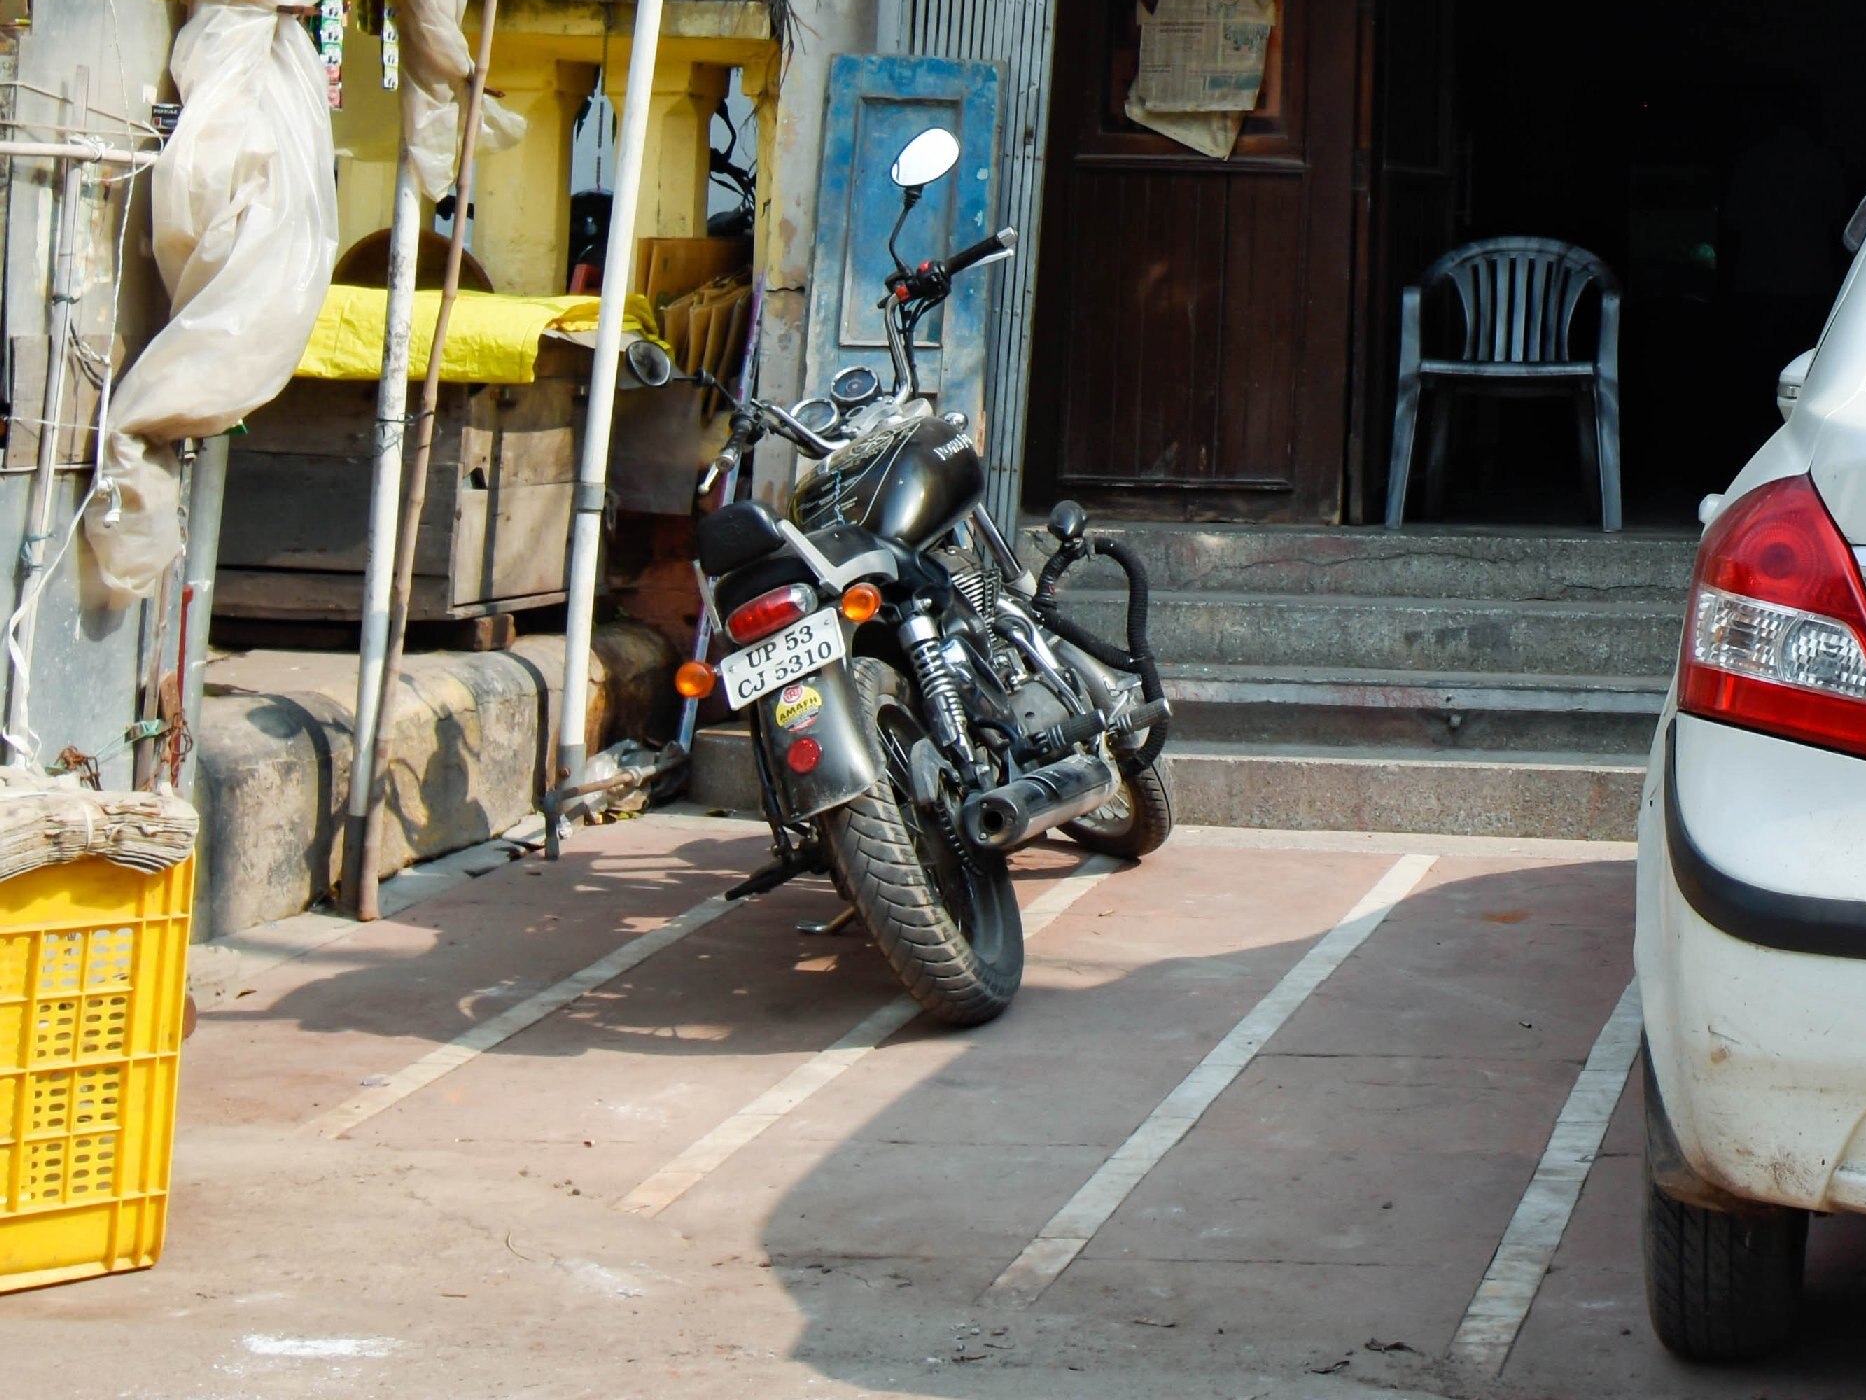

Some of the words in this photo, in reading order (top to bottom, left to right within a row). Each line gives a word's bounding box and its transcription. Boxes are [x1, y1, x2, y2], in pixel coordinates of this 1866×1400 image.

[737, 673, 766, 699] CJ
[774, 641, 833, 680] 5310
[746, 641, 778, 669] UP
[783, 624, 815, 652] 53
